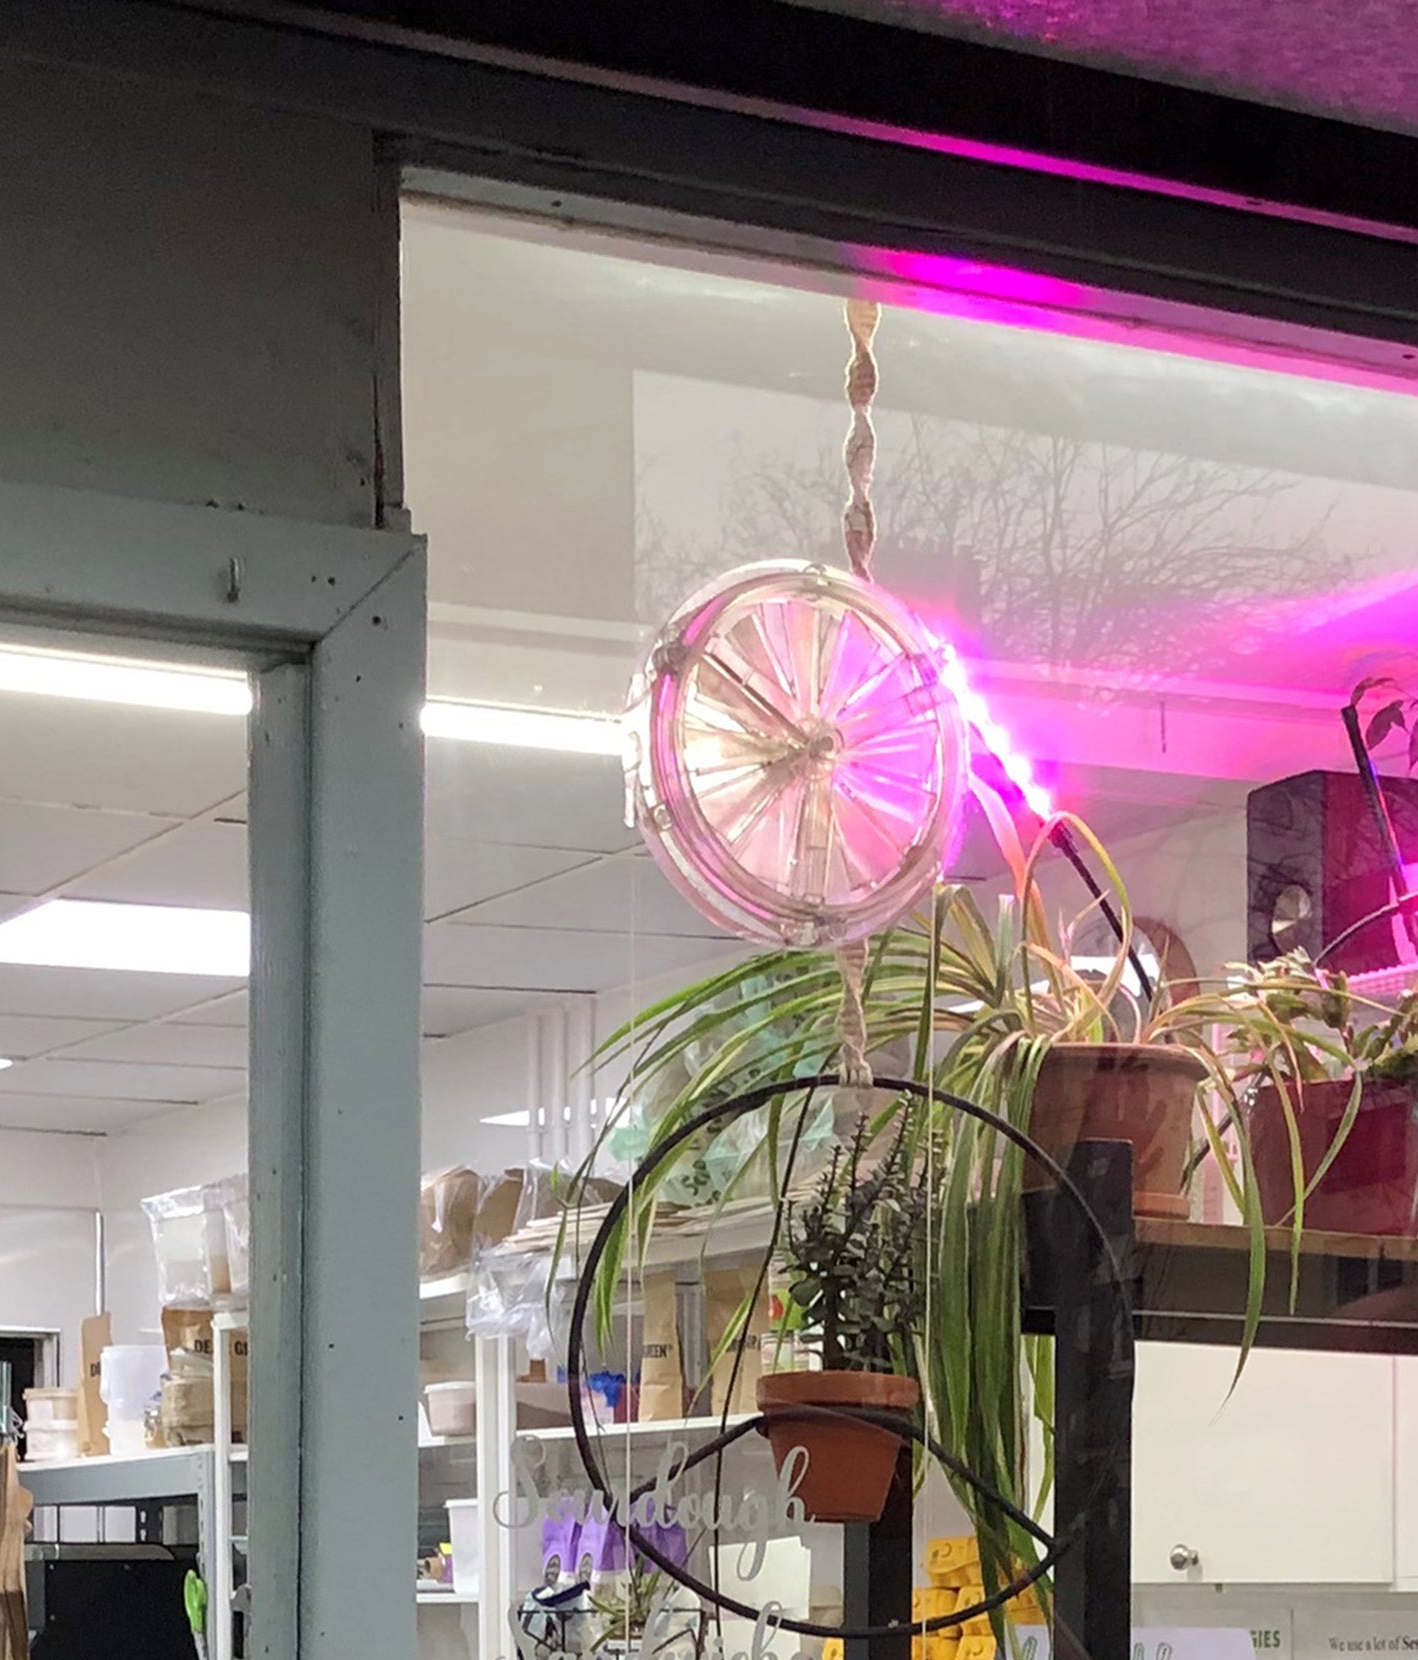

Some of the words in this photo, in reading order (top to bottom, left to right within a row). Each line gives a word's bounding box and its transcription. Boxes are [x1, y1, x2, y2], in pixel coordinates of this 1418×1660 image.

[492, 1434, 818, 1582] Sourdough
[1328, 1637, 1345, 1651] We
[1347, 1641, 1363, 1651] use
[1365, 1641, 1372, 1651] a
[1373, 1637, 1386, 1651] lot
[1388, 1636, 1402, 1651] of
